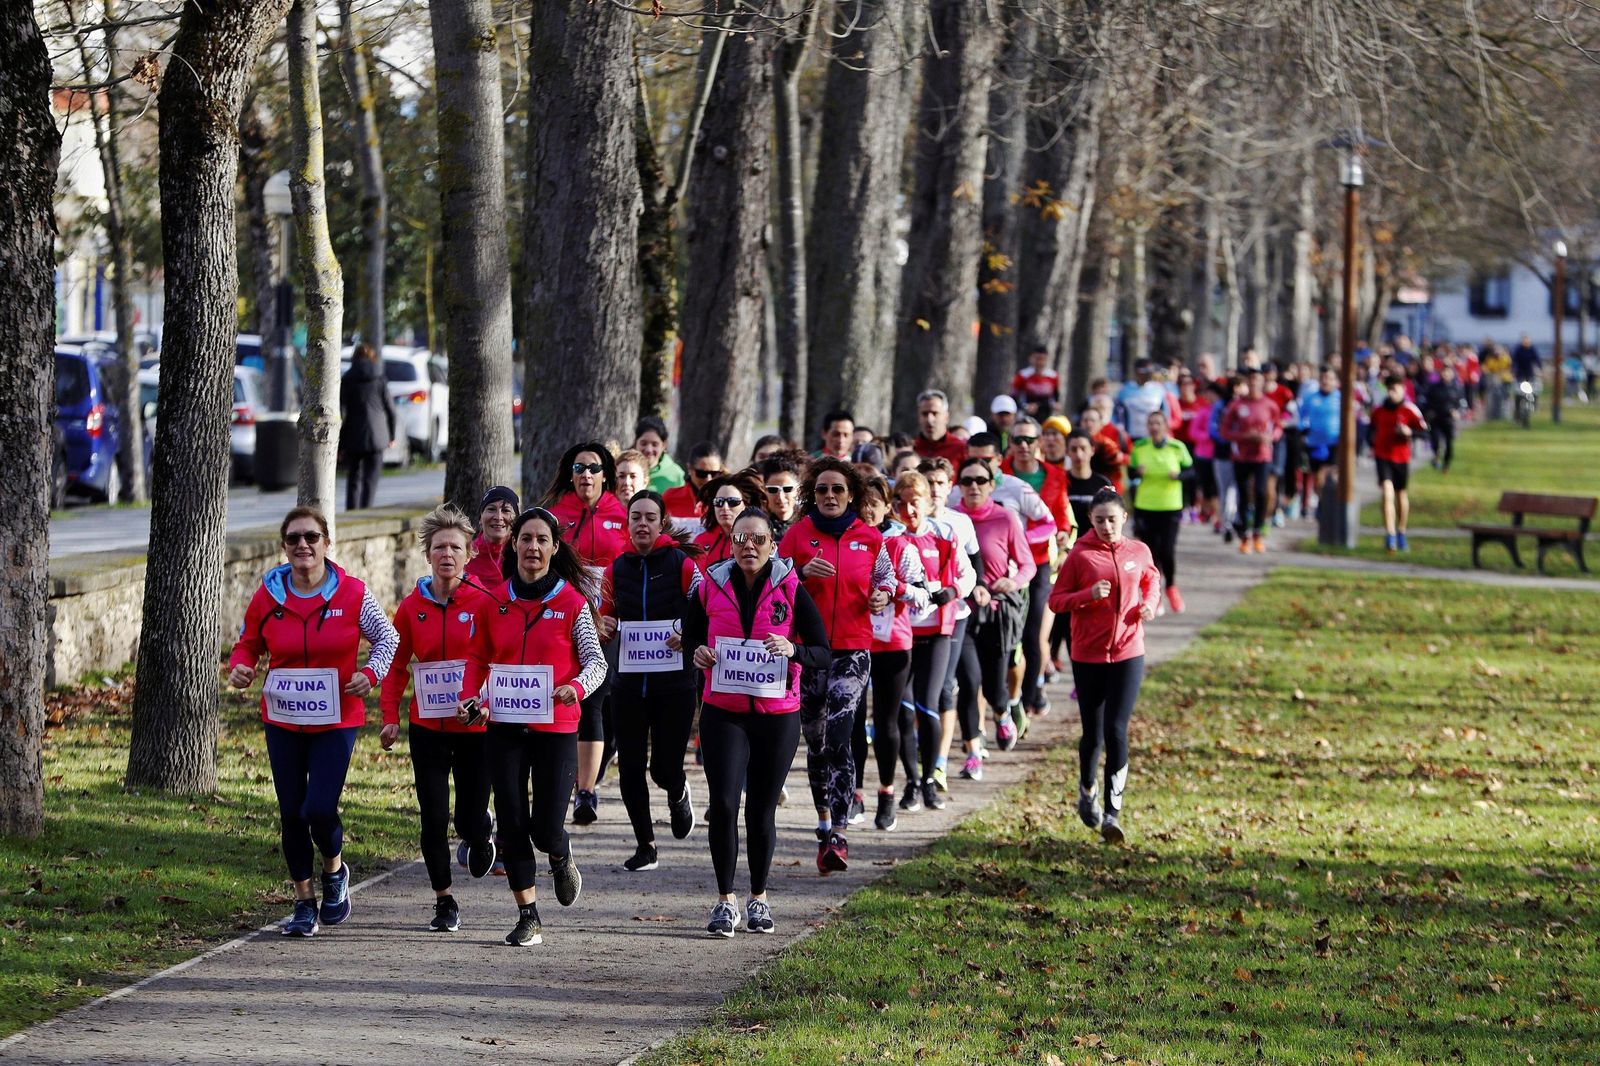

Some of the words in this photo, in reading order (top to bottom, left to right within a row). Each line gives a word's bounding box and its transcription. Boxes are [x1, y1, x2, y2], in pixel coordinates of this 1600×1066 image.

[628, 632, 640, 642] NI
[628, 649, 673, 660] MENOS
[726, 649, 741, 661] NI
[745, 651, 776, 664] UNA
[425, 673, 438, 684] NI
[442, 671, 463, 683] UN
[496, 676, 508, 687] NI
[510, 677, 541, 689] UNA
[724, 669, 775, 684] MENOS
[276, 680, 291, 691] NI
[295, 680, 326, 691] UNA
[427, 691, 460, 705] MEN
[495, 696, 541, 709] MENOS
[276, 699, 328, 712] MENOS
